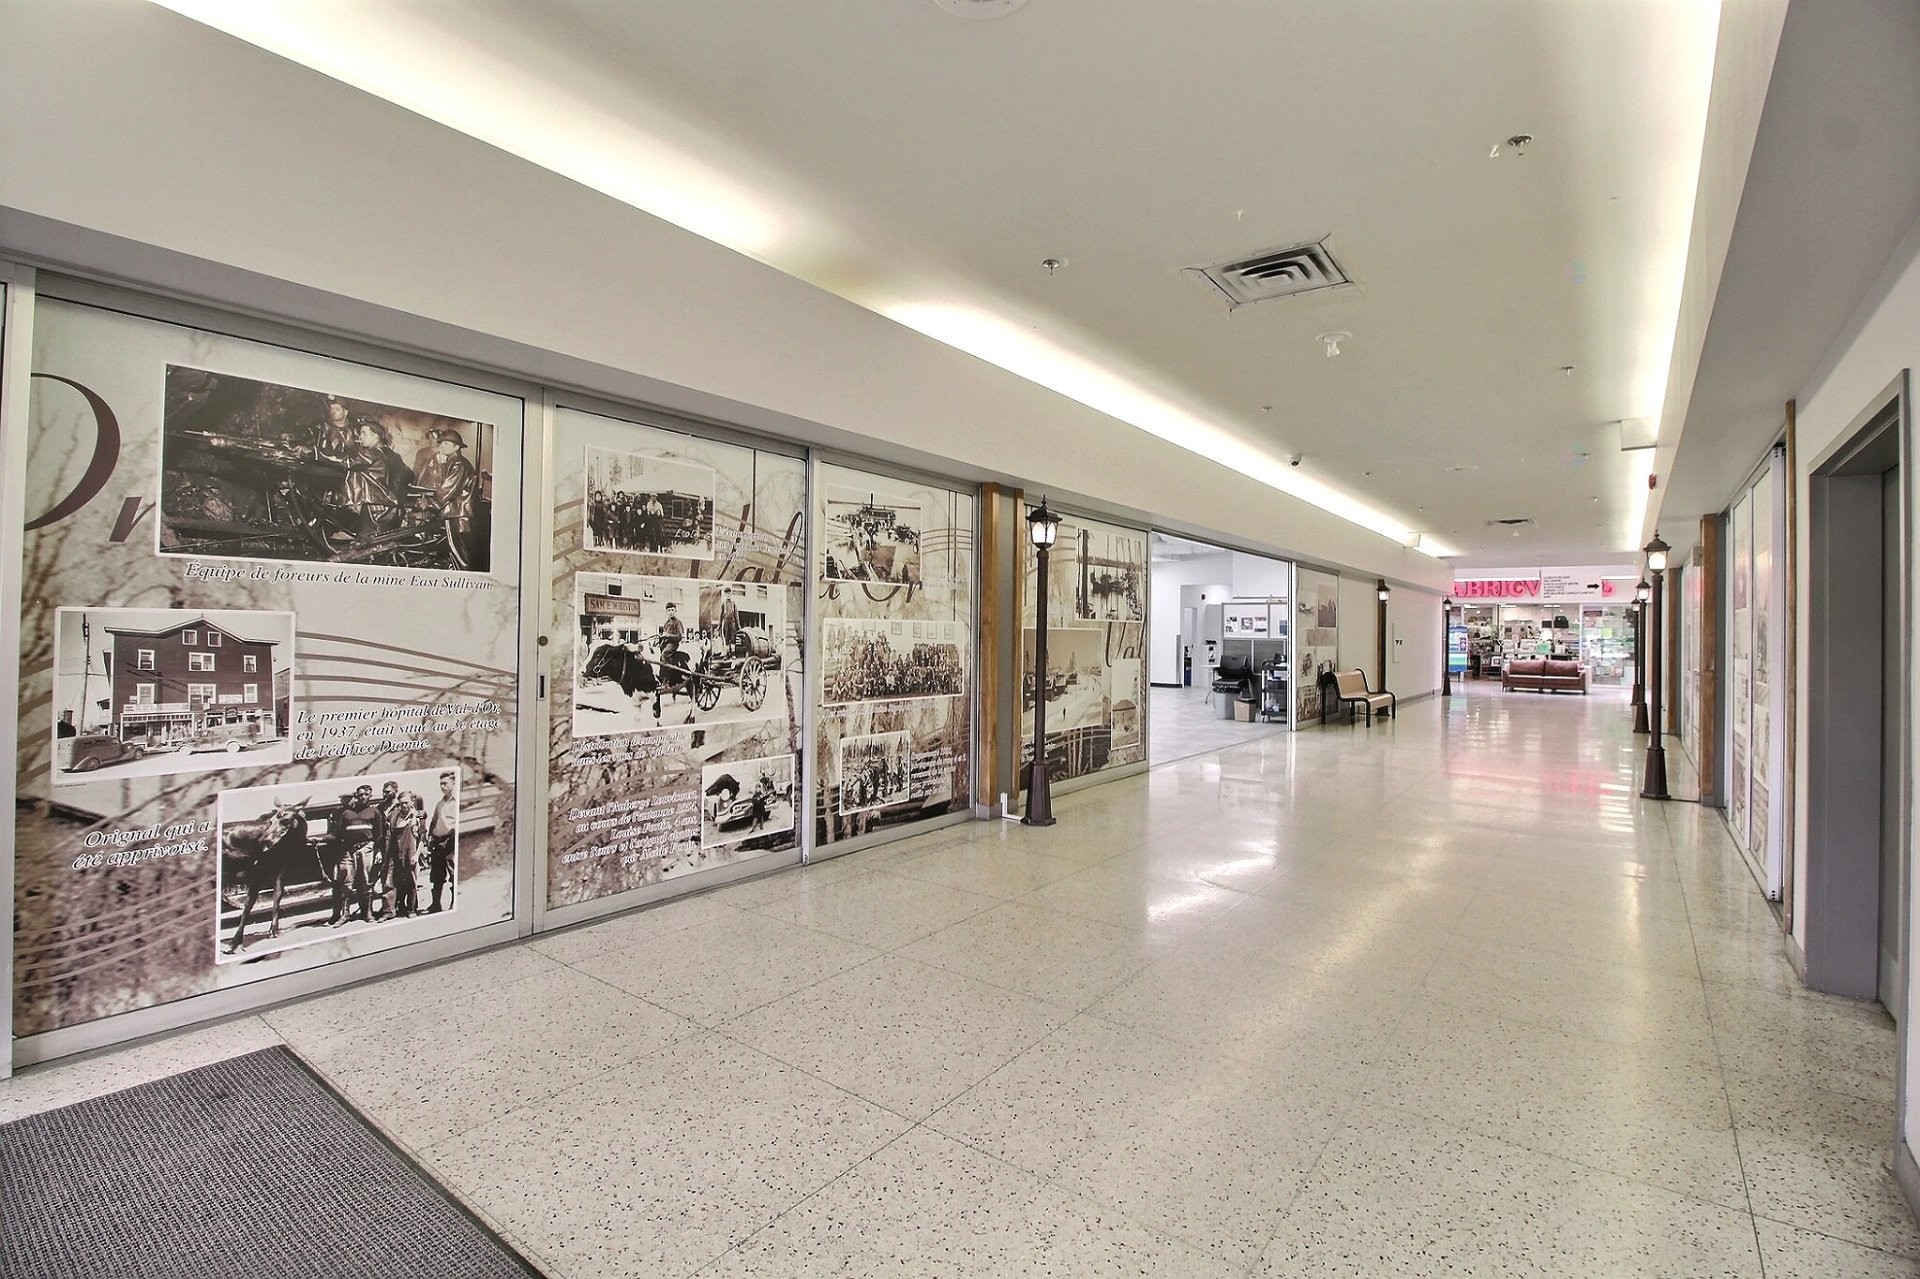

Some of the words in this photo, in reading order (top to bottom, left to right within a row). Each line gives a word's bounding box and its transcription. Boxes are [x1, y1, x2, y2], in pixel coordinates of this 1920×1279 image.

[185, 559, 246, 581] Équipe
[249, 565, 269, 581] de
[272, 567, 330, 584] foreurs
[333, 569, 352, 584] de
[355, 571, 370, 586] la
[372, 574, 406, 587] mine
[409, 576, 439, 588] East
[297, 710, 316, 725] Le
[319, 707, 378, 726] premier
[381, 703, 430, 721] hôpital
[296, 730, 315, 742] en
[320, 724, 360, 741] 1937,
[363, 721, 395, 737] était
[399, 718, 429, 734] situé
[432, 721, 449, 732] au
[468, 717, 501, 733] étage
[295, 745, 316, 761] de
[317, 740, 376, 759] l'édifice
[568, 805, 605, 821] Devant
[84, 823, 161, 848] Orignal
[164, 819, 195, 841] qui
[197, 820, 212, 834] a
[575, 822, 589, 834] au
[72, 850, 103, 871] été
[106, 837, 209, 868] apprivoisé.
